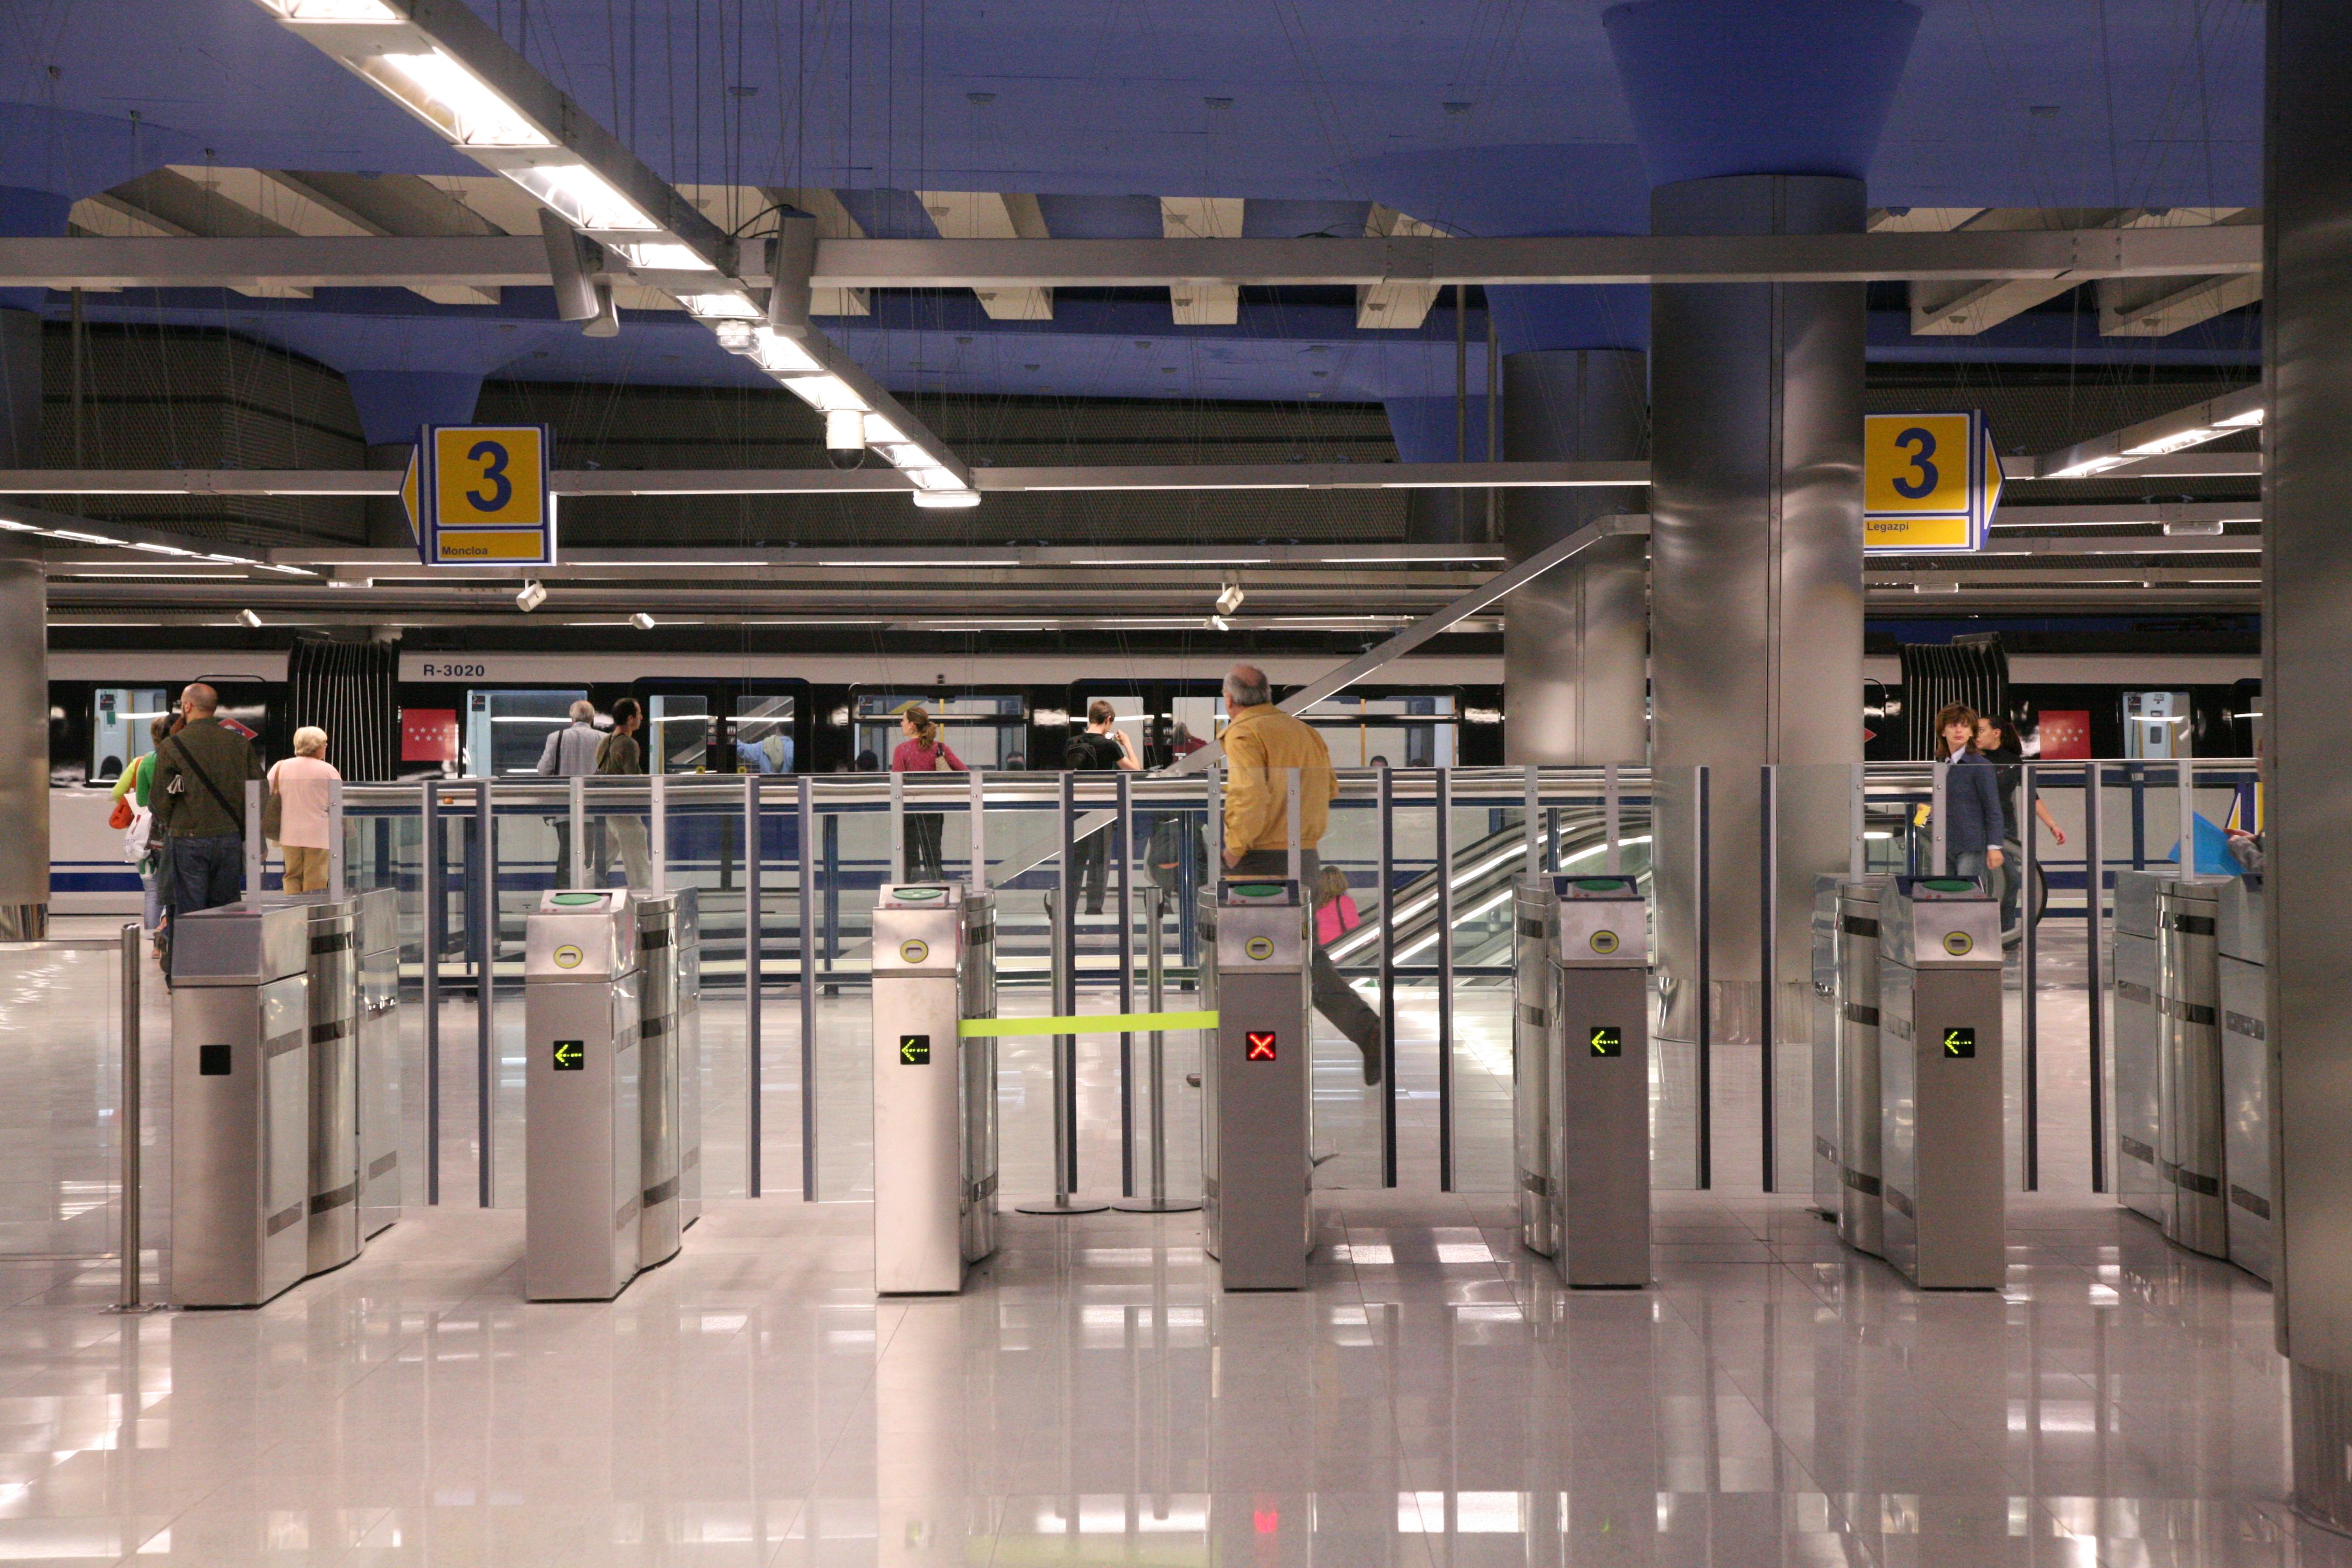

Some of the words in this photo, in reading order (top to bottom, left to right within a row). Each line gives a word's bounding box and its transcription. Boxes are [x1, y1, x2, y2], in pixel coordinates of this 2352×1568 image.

[1892, 428, 1938, 499] 3
[465, 440, 512, 512] 3
[1867, 521, 1909, 533] Legazpi
[442, 546, 488, 556] Moncloa
[423, 664, 485, 677] R-3020
